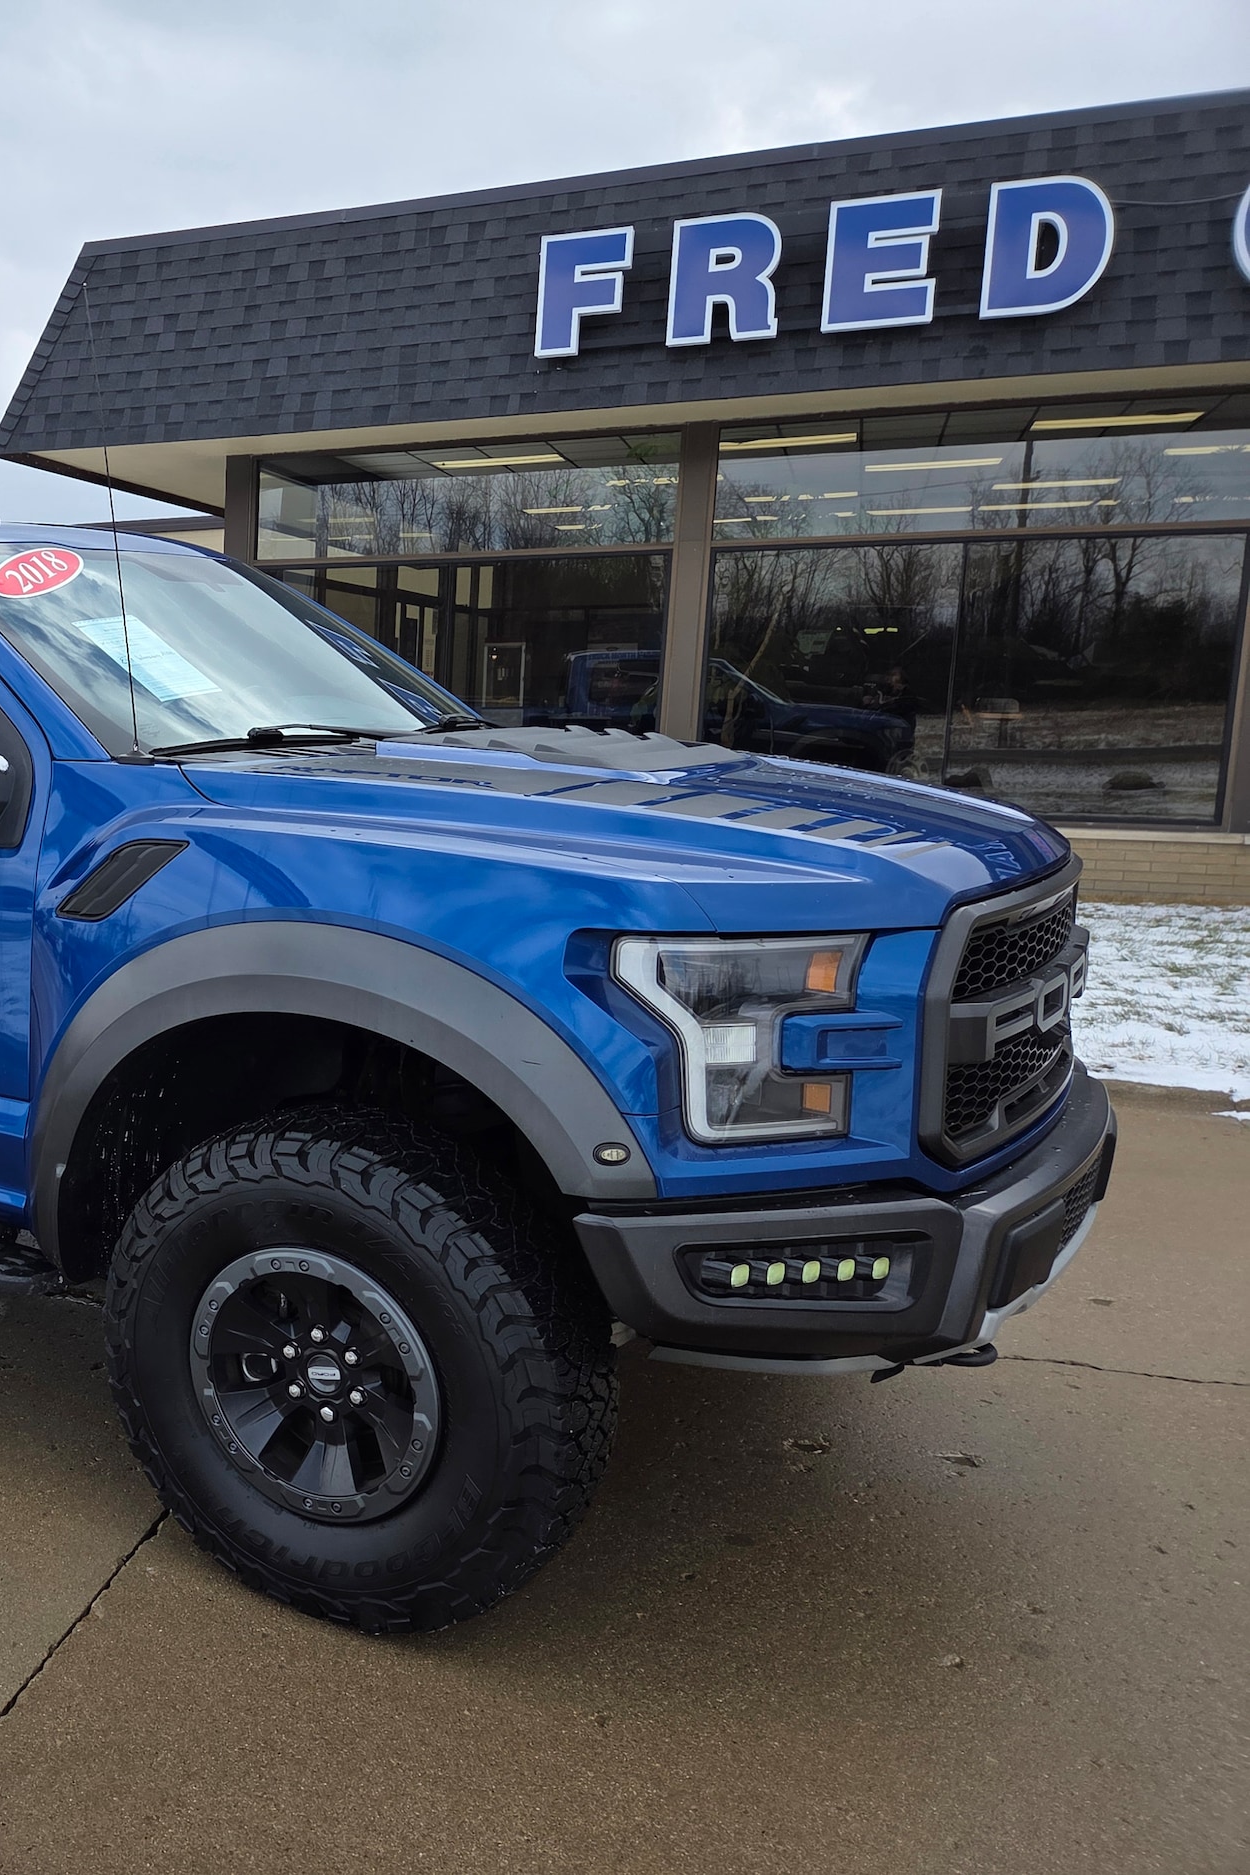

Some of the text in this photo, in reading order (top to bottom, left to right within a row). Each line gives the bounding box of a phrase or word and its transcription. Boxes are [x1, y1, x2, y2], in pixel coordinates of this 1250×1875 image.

[533, 175, 1115, 358] FRED
[5, 550, 69, 594] 2018
[272, 764, 498, 790] RAPTOR
[985, 950, 1087, 1063] FOR
